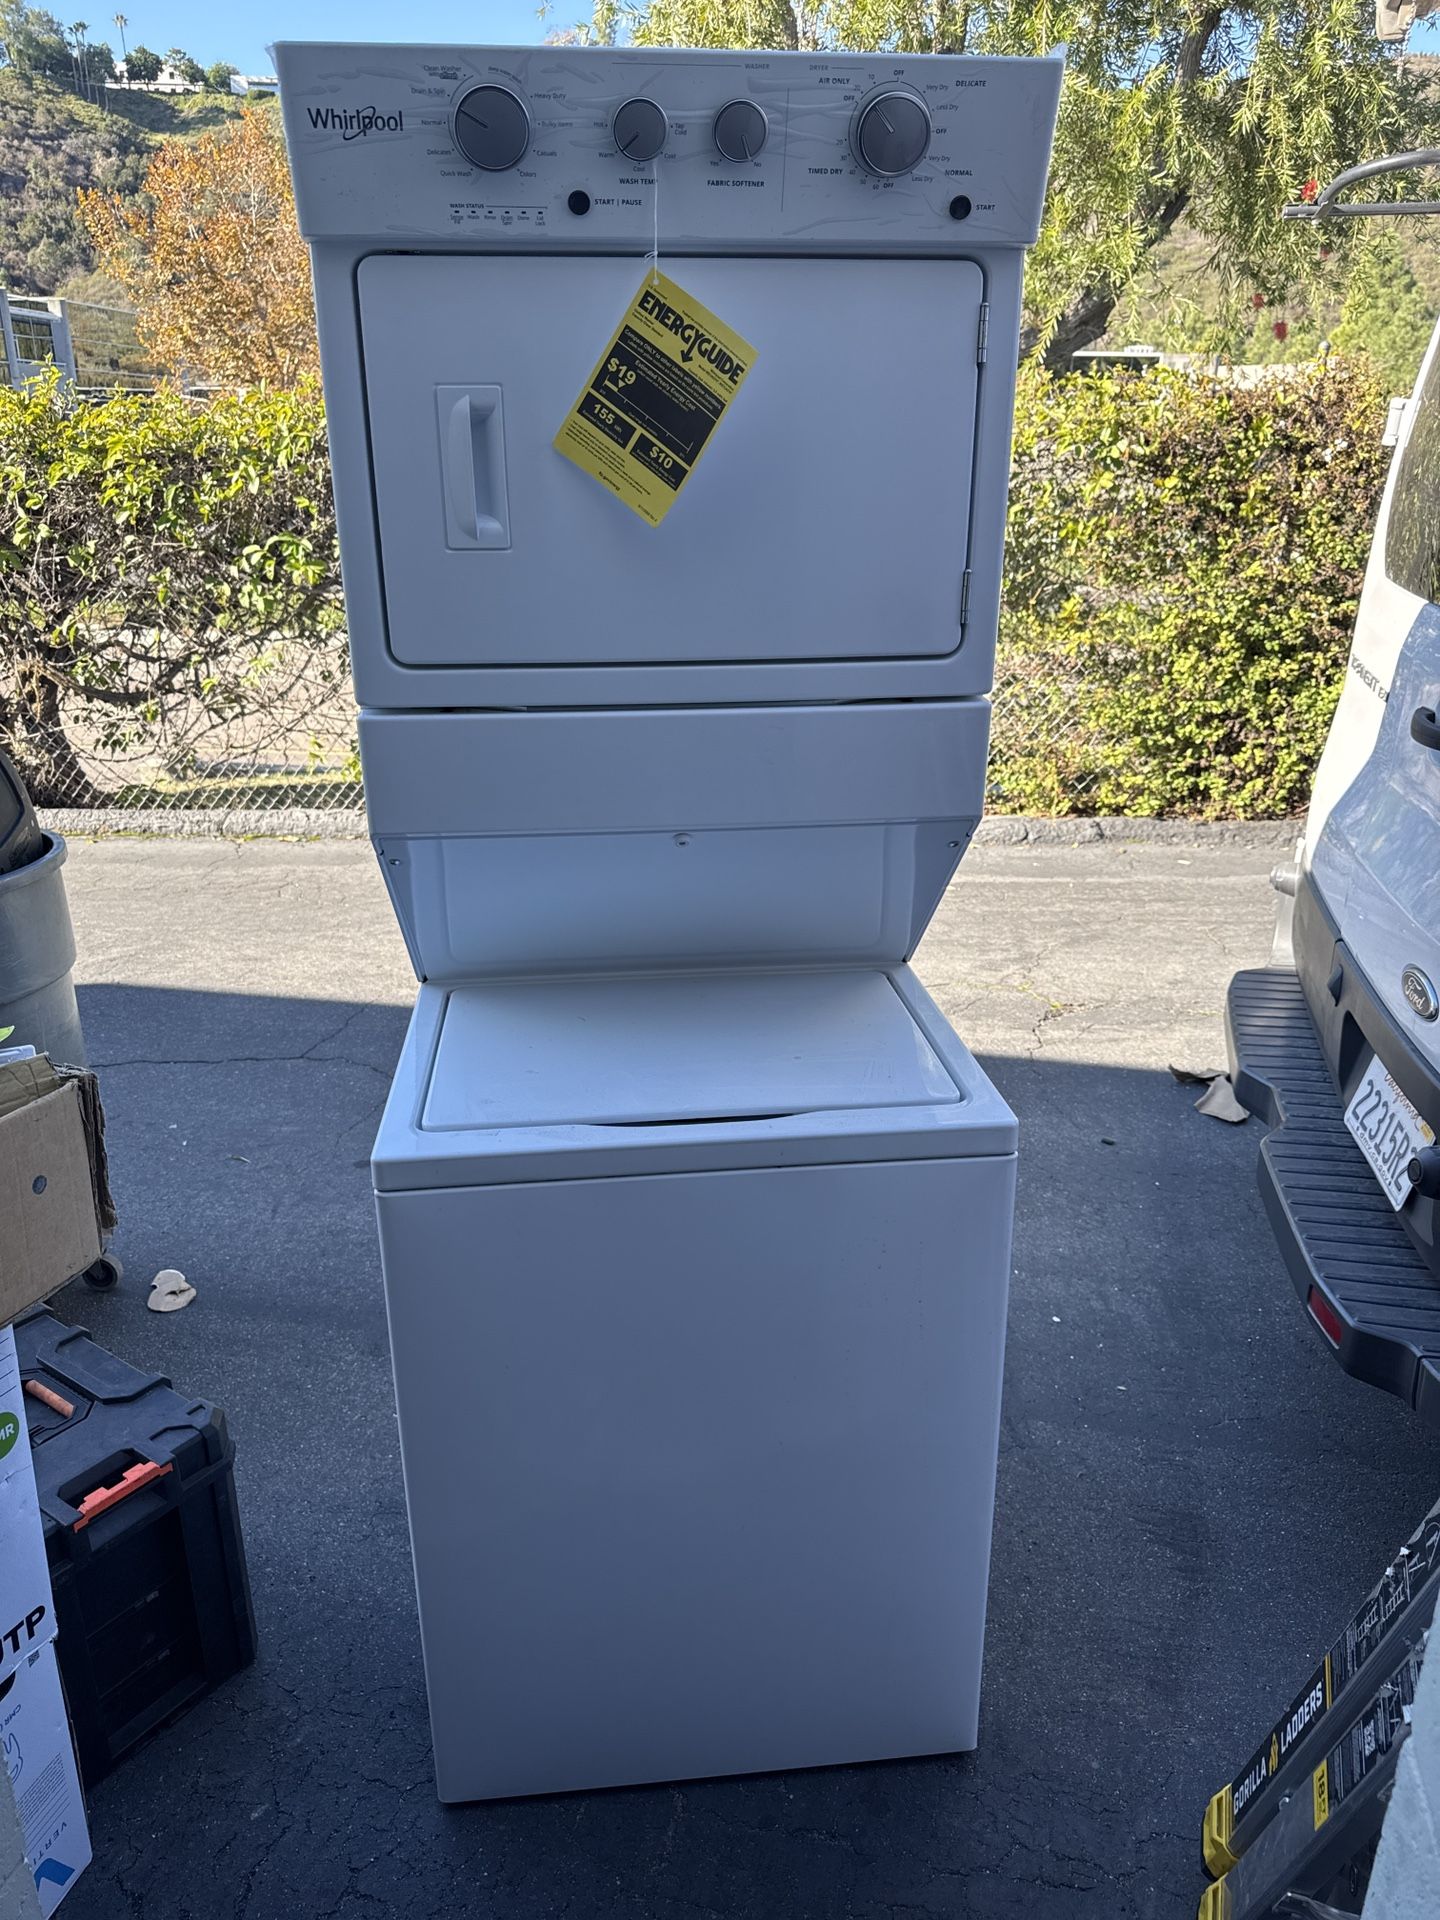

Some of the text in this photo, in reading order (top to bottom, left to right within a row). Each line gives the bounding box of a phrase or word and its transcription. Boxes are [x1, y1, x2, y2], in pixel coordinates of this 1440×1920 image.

[306, 106, 403, 140] Whirlpool
[623, 327, 644, 347] Compare
[642, 342, 657, 357] ONLY
[638, 289, 745, 386] ENERGYGUIDE
[607, 357, 635, 385] $19
[634, 358, 658, 380] Estimated
[655, 375, 671, 391] Yearly
[669, 386, 687, 404] Energy
[684, 398, 697, 411] Cost
[594, 403, 614, 424] 155
[649, 445, 673, 467] $10
[1404, 976, 1427, 1010] Ford
[0, 1605, 46, 1664] TP
[1233, 1681, 1323, 1815] GORILLA LADDERS
